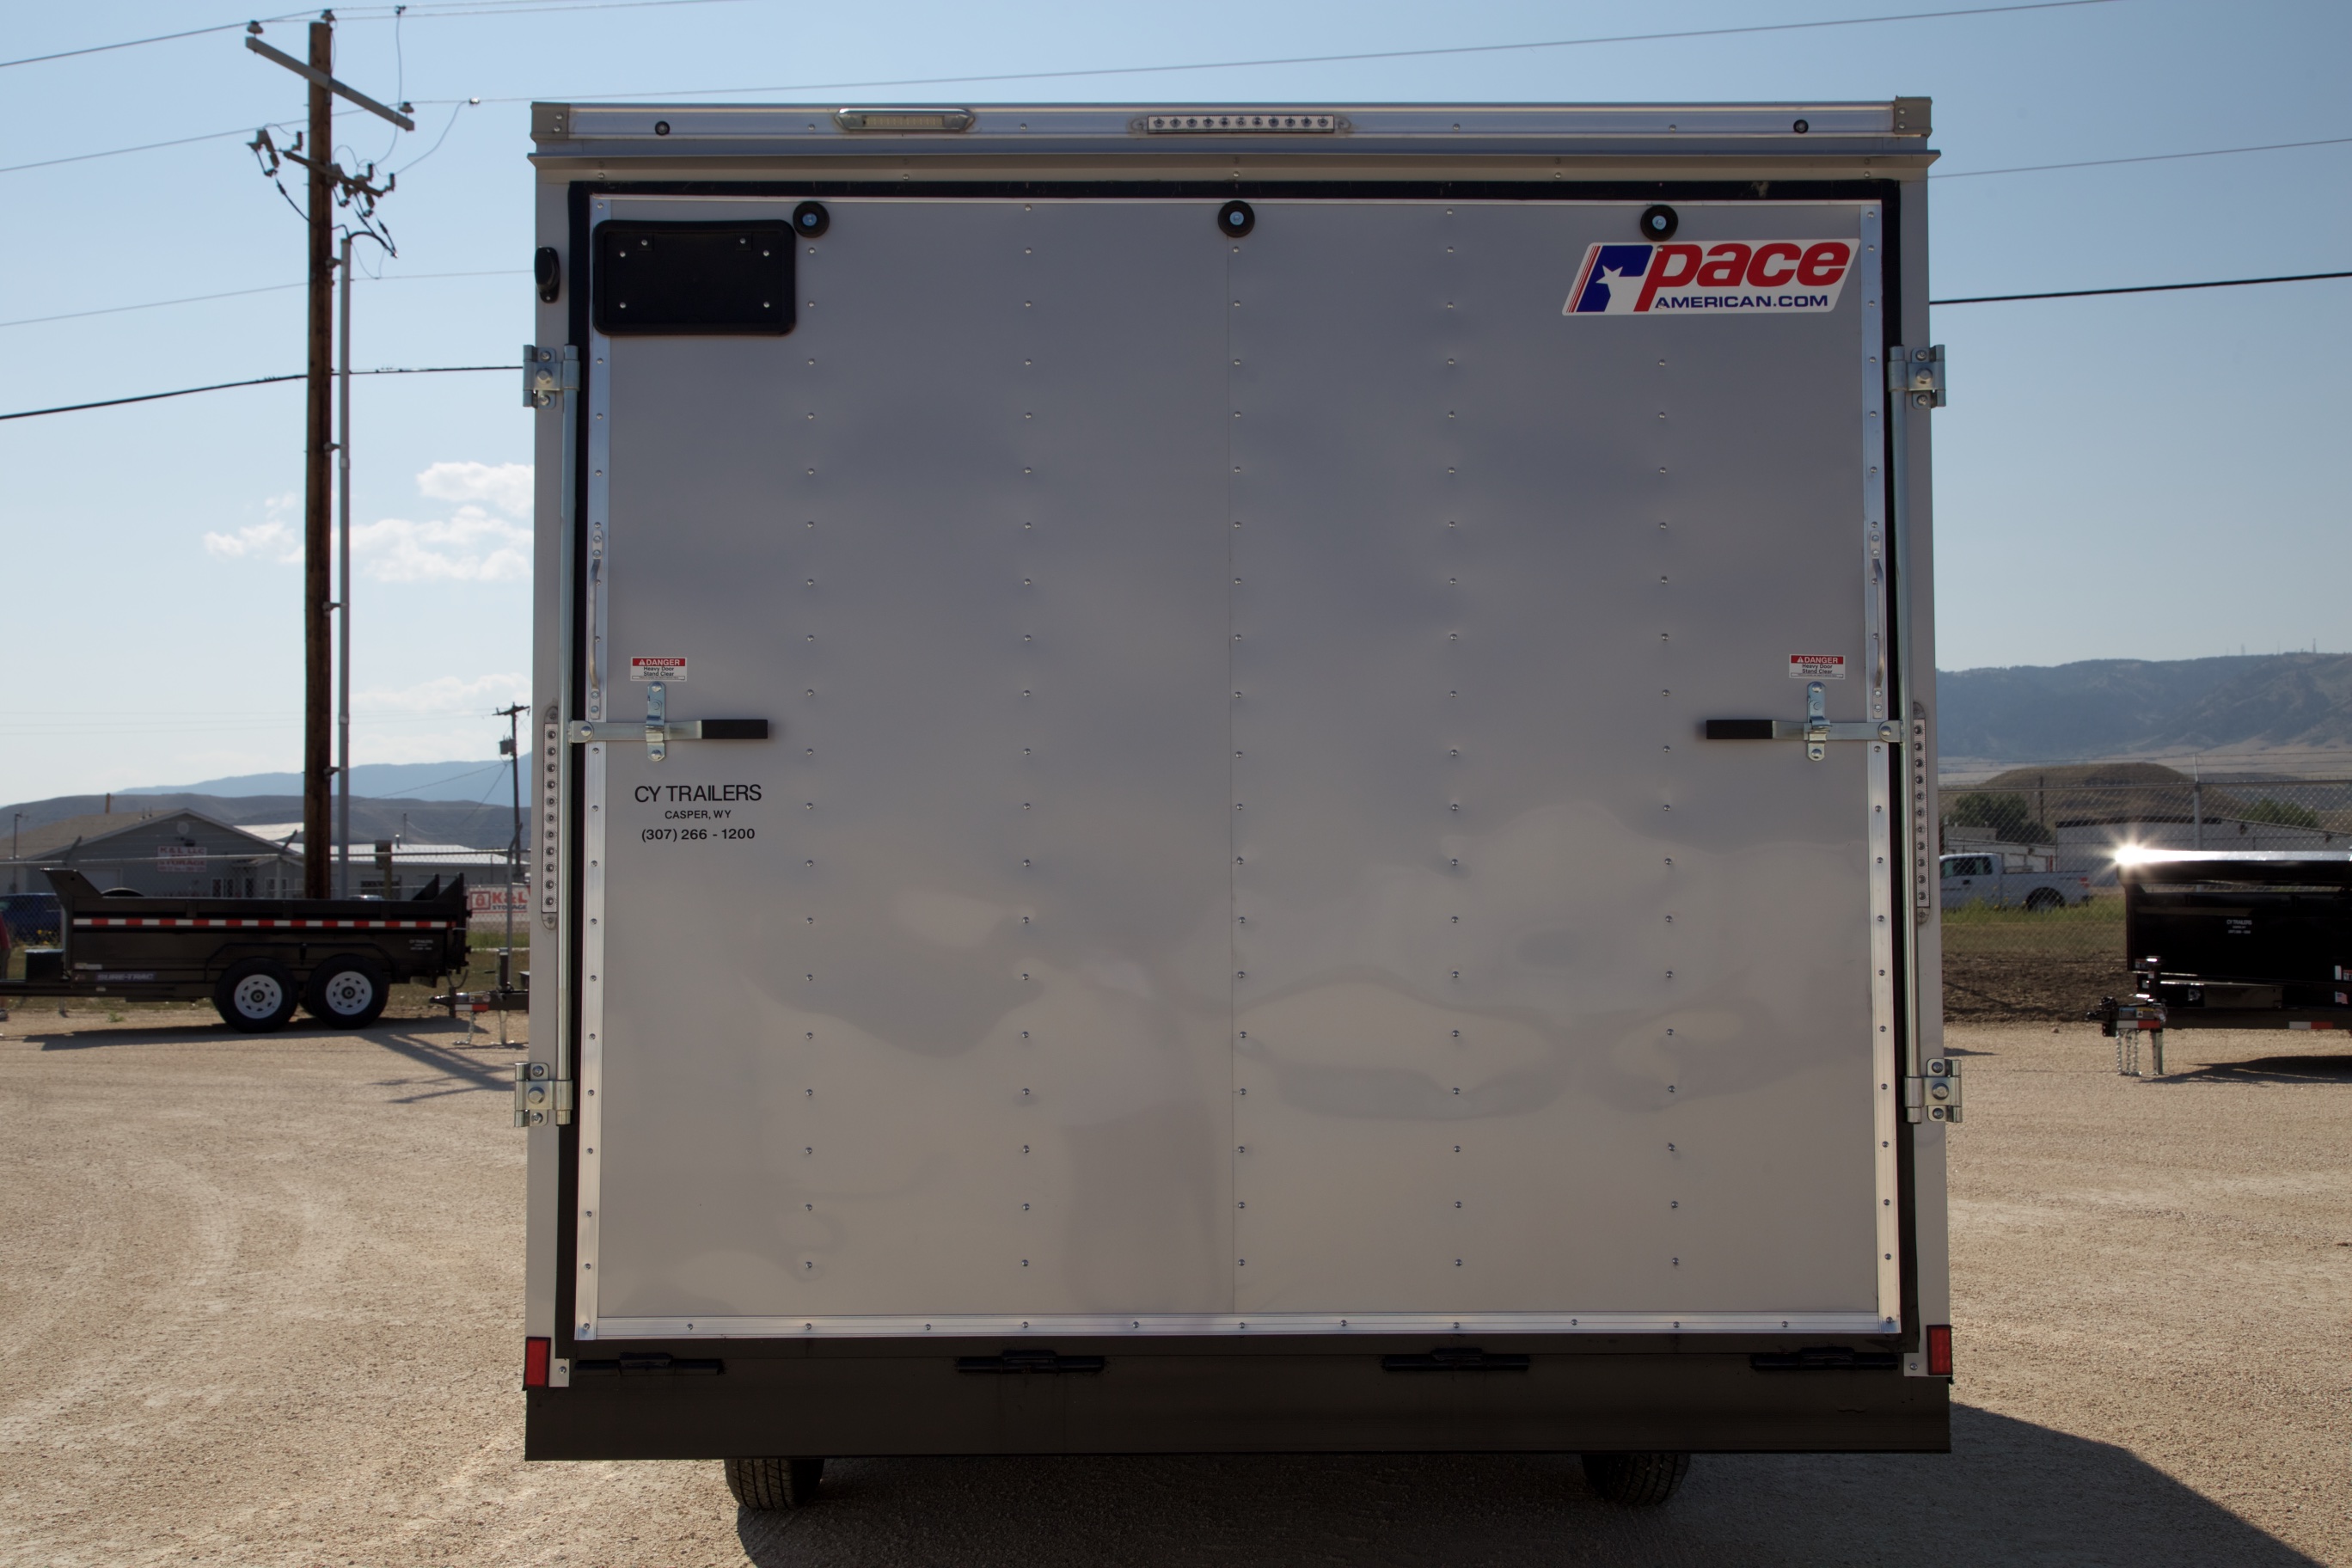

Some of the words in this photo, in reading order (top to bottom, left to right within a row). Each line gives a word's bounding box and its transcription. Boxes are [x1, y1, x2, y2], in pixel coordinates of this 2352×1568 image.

[1633, 242, 1851, 312] pace
[1655, 294, 1828, 309] AMERICAN.COM
[634, 785, 662, 803] CY
[665, 783, 763, 802] TRAILERS
[665, 810, 712, 820] CASPER,
[714, 810, 732, 818] WY
[641, 829, 677, 842] (307)
[681, 829, 707, 840] 266
[721, 828, 756, 839] 1200
